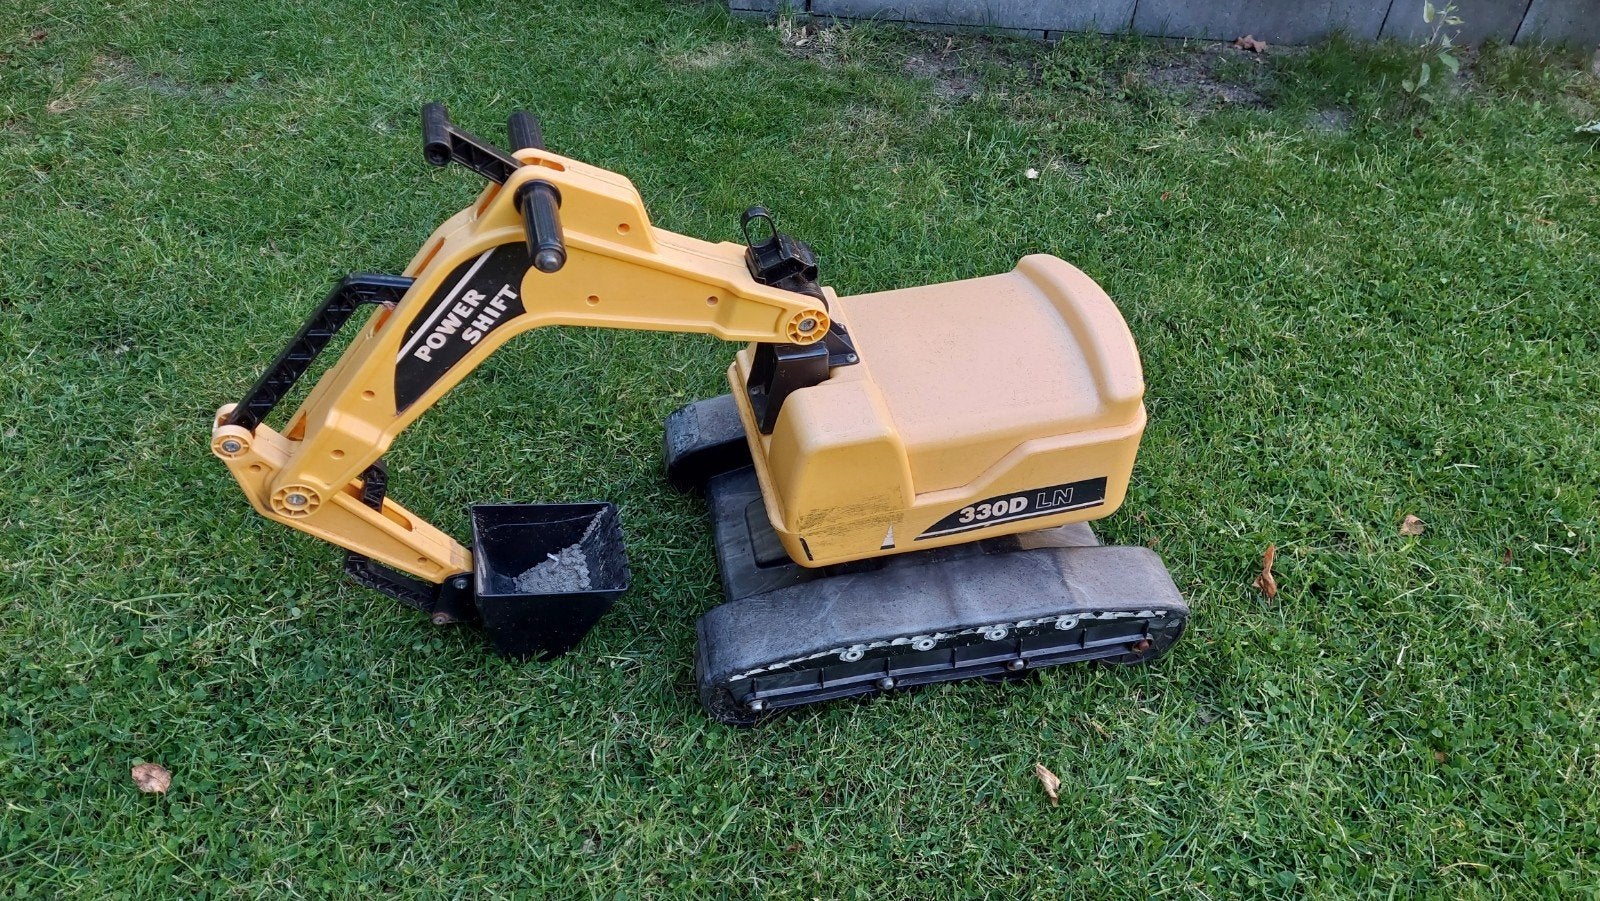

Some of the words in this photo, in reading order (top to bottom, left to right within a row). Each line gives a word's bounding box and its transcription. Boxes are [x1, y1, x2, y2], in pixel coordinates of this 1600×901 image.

[413, 288, 487, 362] POWER
[461, 283, 518, 345] SHIFT
[958, 496, 1028, 524] 330D
[1035, 487, 1074, 509] LN
